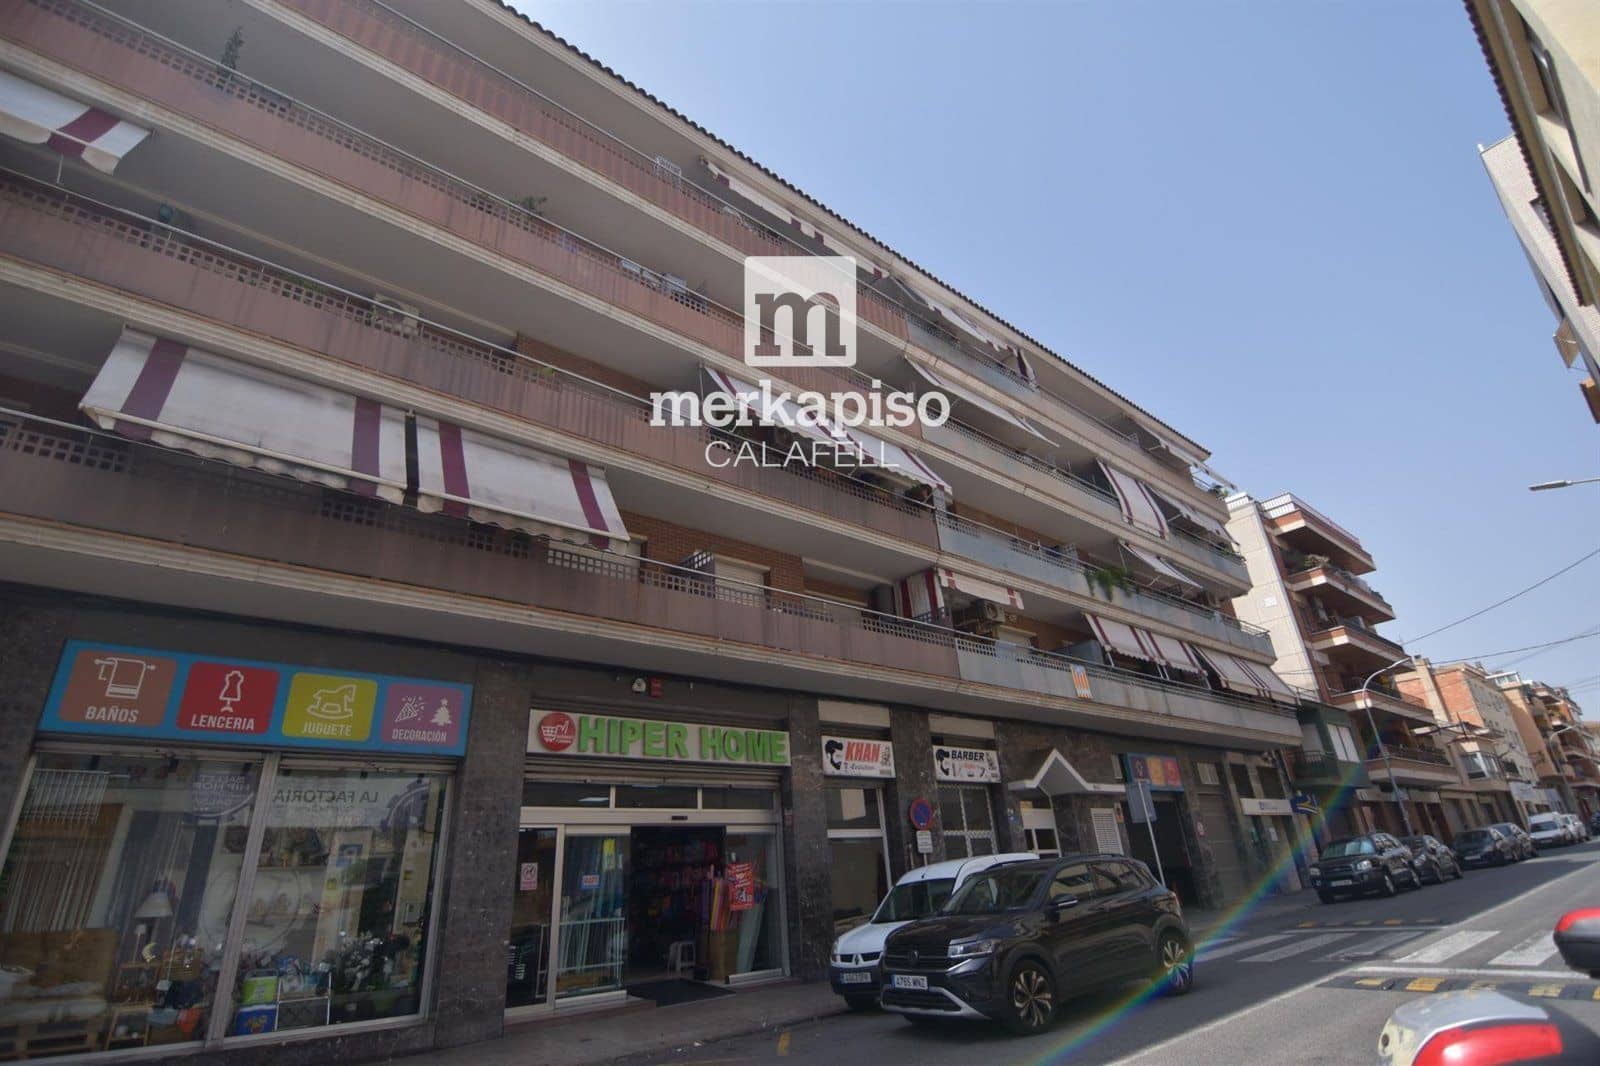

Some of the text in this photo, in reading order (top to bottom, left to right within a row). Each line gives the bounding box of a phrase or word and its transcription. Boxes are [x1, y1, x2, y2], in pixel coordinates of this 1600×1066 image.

[85, 705, 139, 723] BAÑOS
[190, 713, 255, 731] LENCERIA
[302, 720, 352, 737] JUGUETE
[578, 716, 788, 763] HIPER HOME
[845, 740, 881, 763] KHAN
[951, 749, 985, 761] BARBER
